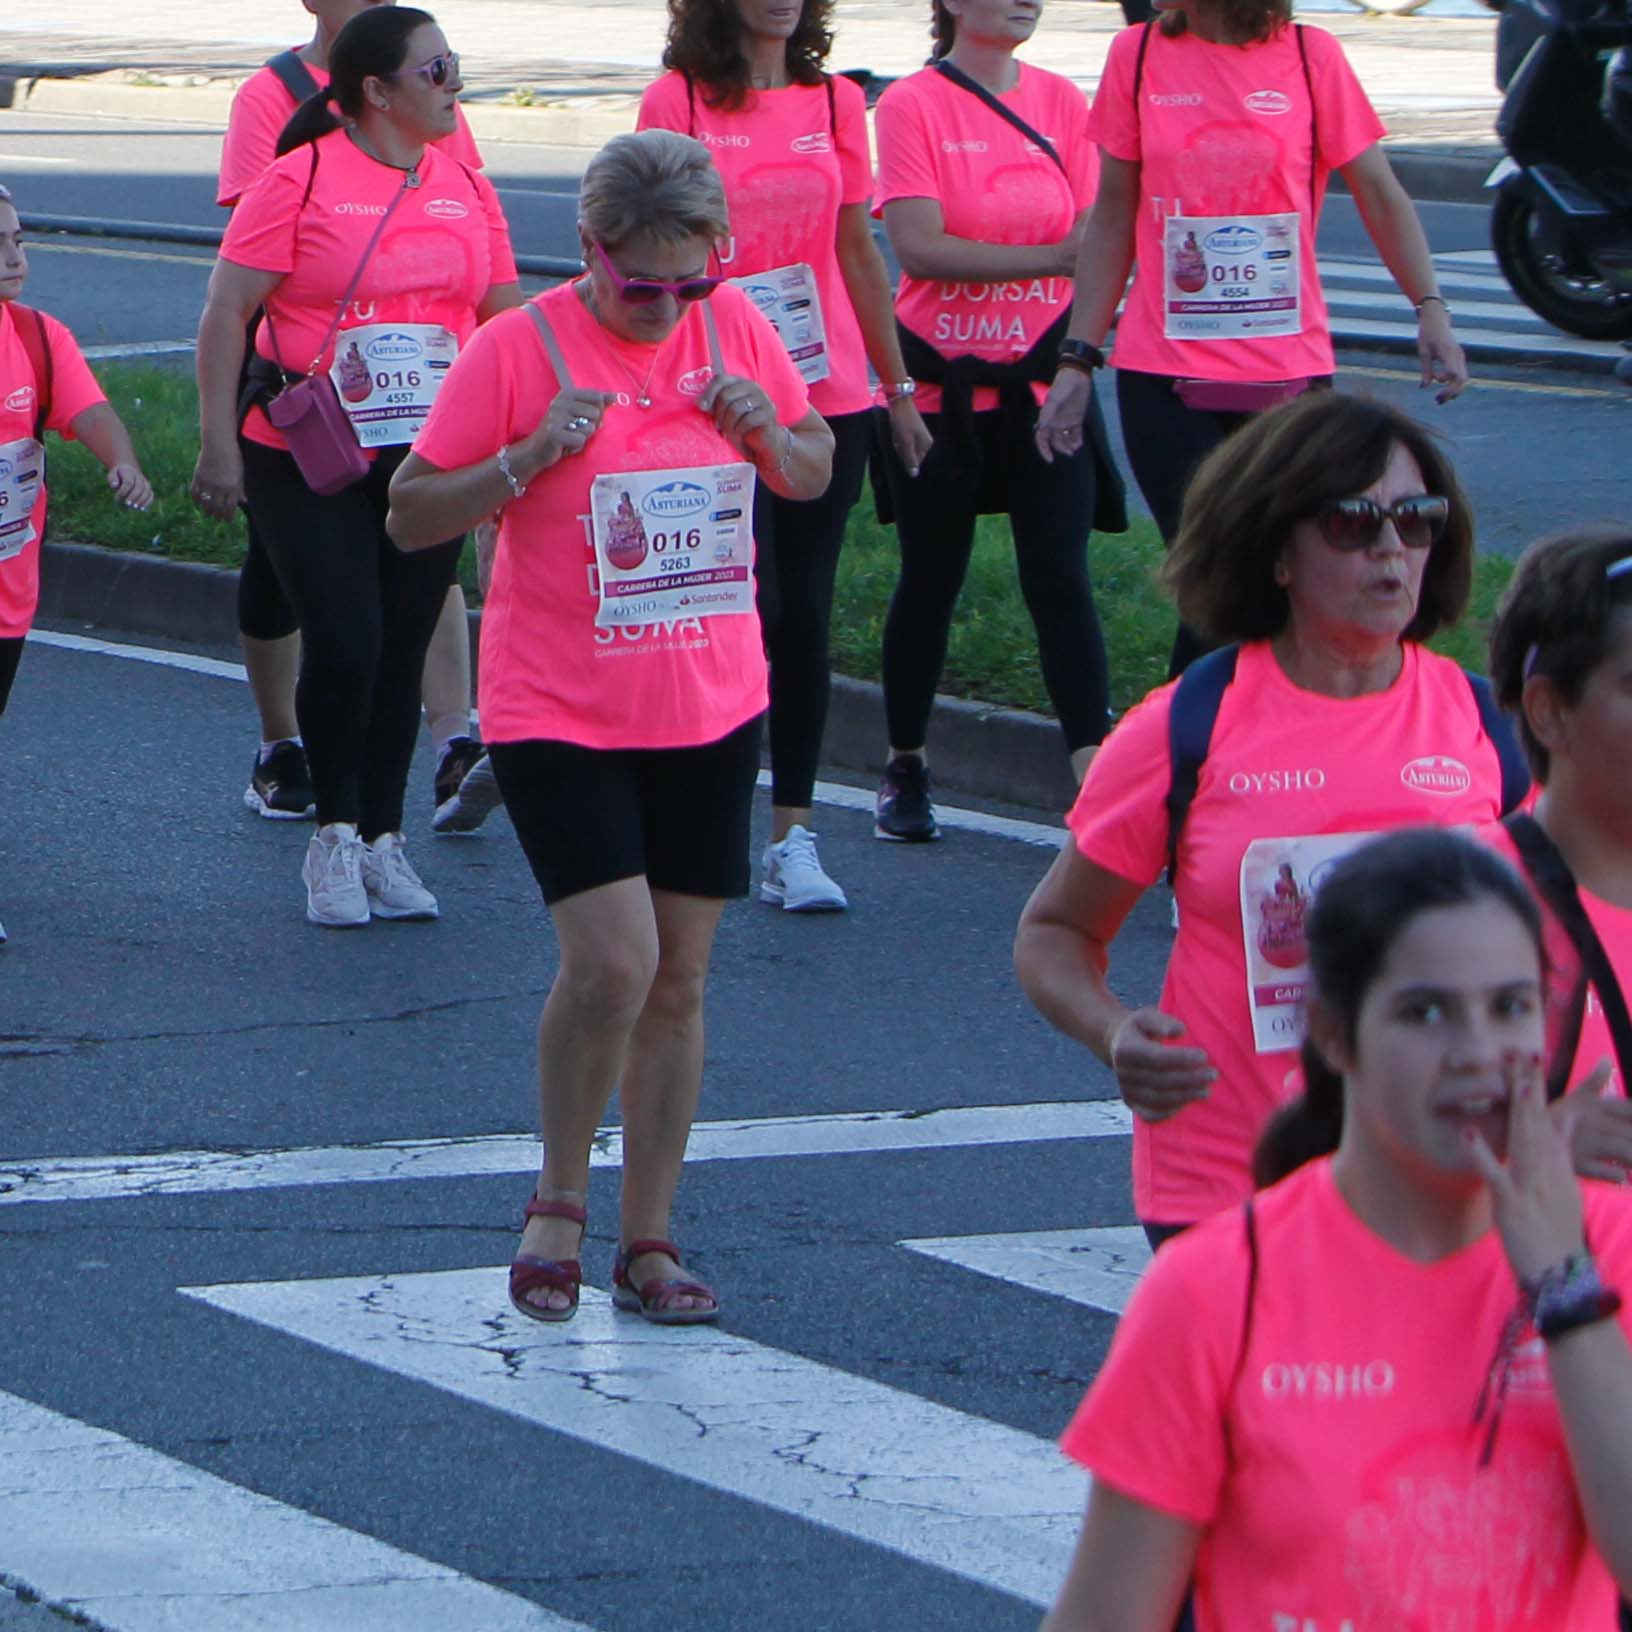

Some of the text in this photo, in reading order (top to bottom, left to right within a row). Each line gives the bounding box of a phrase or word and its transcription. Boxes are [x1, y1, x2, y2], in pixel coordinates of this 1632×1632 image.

[335, 202, 387, 216] OYSHO
[1212, 264, 1257, 282] 016
[940, 278, 1059, 304] DORSAL
[1220, 288, 1250, 298] 4554
[935, 313, 1026, 341] SUMA
[376, 370, 421, 389] 016
[386, 393, 415, 404] 4557
[648, 495, 706, 510] ASTURIANA
[653, 528, 701, 552] 016
[660, 556, 691, 572] 5263
[617, 581, 657, 594] CARRERA
[658, 579, 670, 589] DE
[671, 577, 682, 587] LA
[683, 573, 712, 585] MUJER
[614, 590, 739, 617] OYSHO Santander
[1229, 768, 1325, 793] OYSHO
[1261, 1358, 1395, 1398] OYSHO
